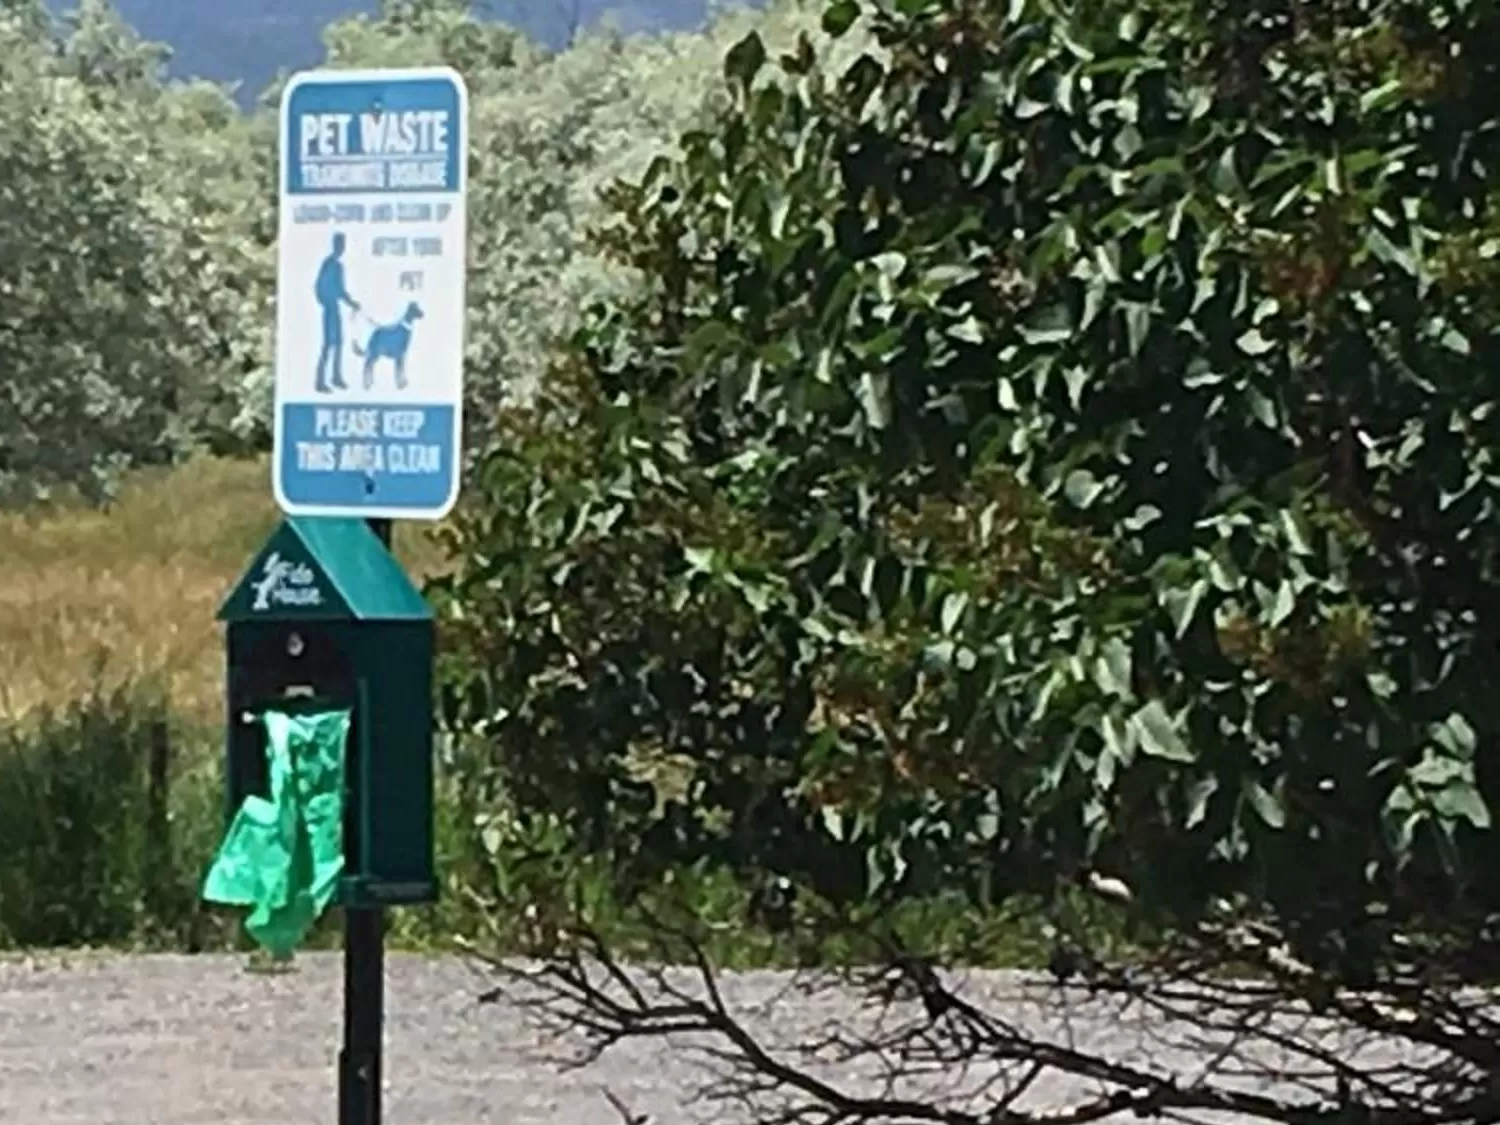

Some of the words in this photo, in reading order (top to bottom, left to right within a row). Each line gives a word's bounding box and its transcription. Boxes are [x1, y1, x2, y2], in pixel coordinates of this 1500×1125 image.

[301, 112, 352, 156] PET
[359, 110, 449, 154] WASTE
[399, 270, 424, 291] PET
[314, 408, 379, 438] PLEASE
[382, 409, 425, 438] KEEP
[296, 441, 335, 471] THIS
[338, 442, 385, 472] AREA
[388, 443, 441, 474] CLEAN
